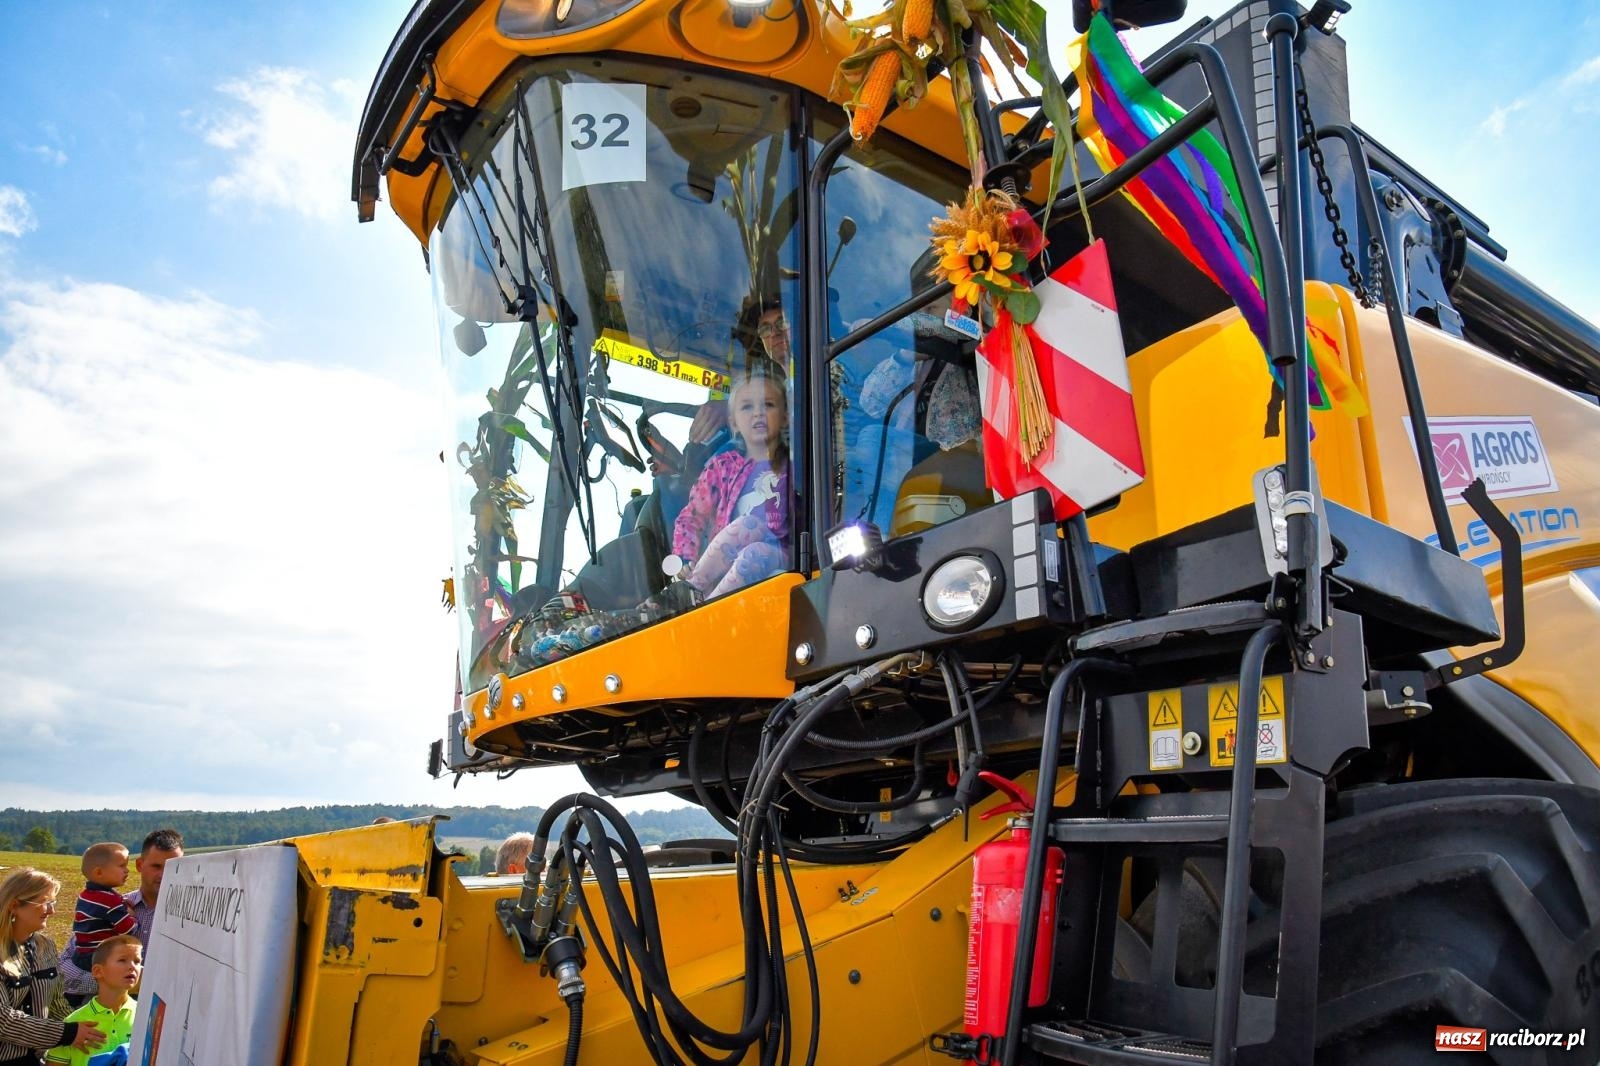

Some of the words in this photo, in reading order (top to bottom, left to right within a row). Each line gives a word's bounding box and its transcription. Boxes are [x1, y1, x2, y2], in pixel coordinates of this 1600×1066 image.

[571, 113, 630, 150] 32
[637, 355, 659, 372] 3.98
[1471, 430, 1540, 468] AGROS
